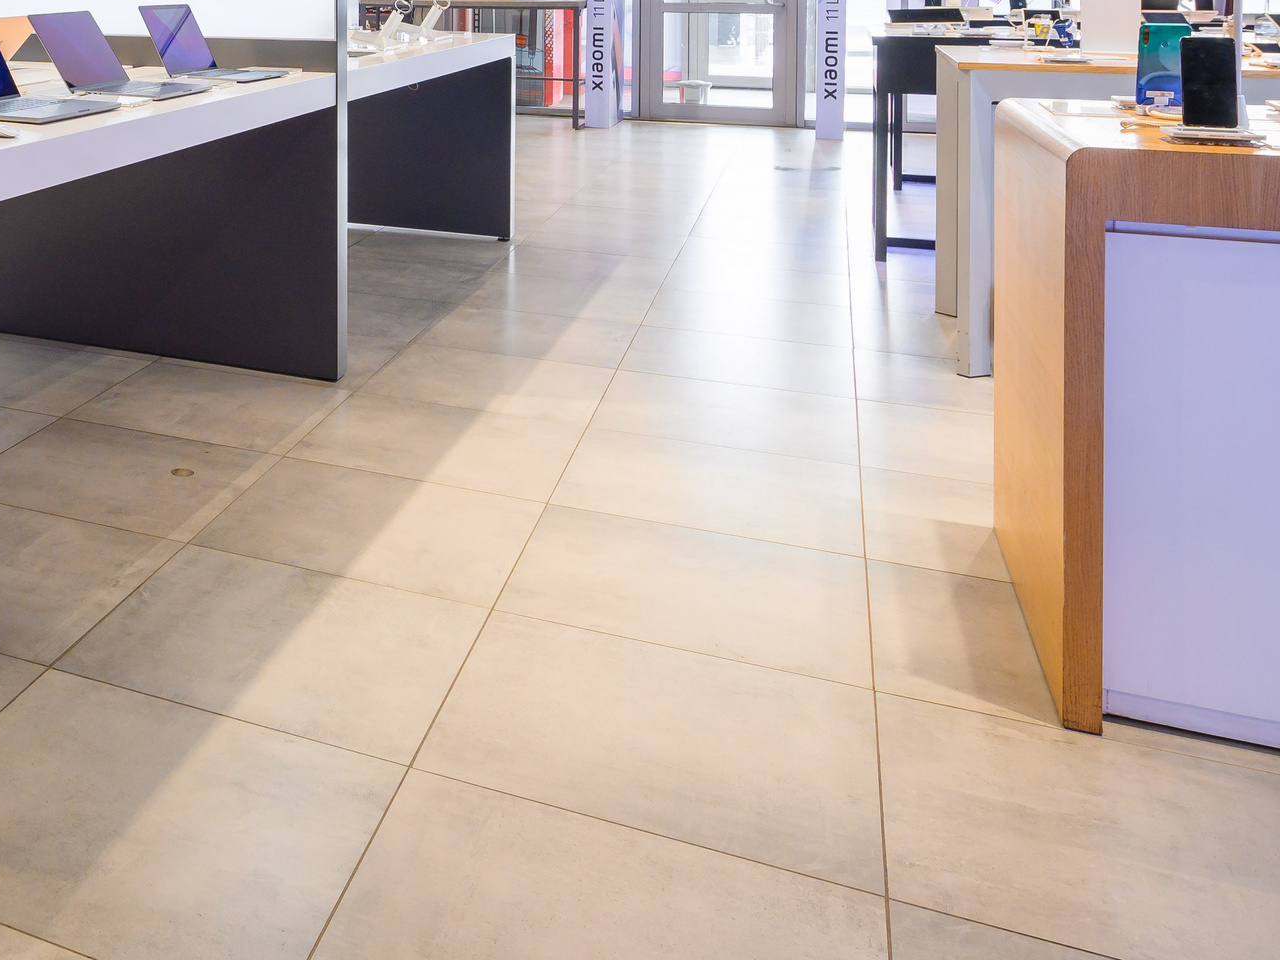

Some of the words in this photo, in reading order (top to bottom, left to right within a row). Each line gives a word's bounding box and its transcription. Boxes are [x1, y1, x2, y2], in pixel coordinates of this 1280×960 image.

[594, 6, 604, 18] 11
[826, 9, 838, 21] 11
[592, 27, 604, 92] xiaomi
[824, 31, 838, 100] xiaomi
